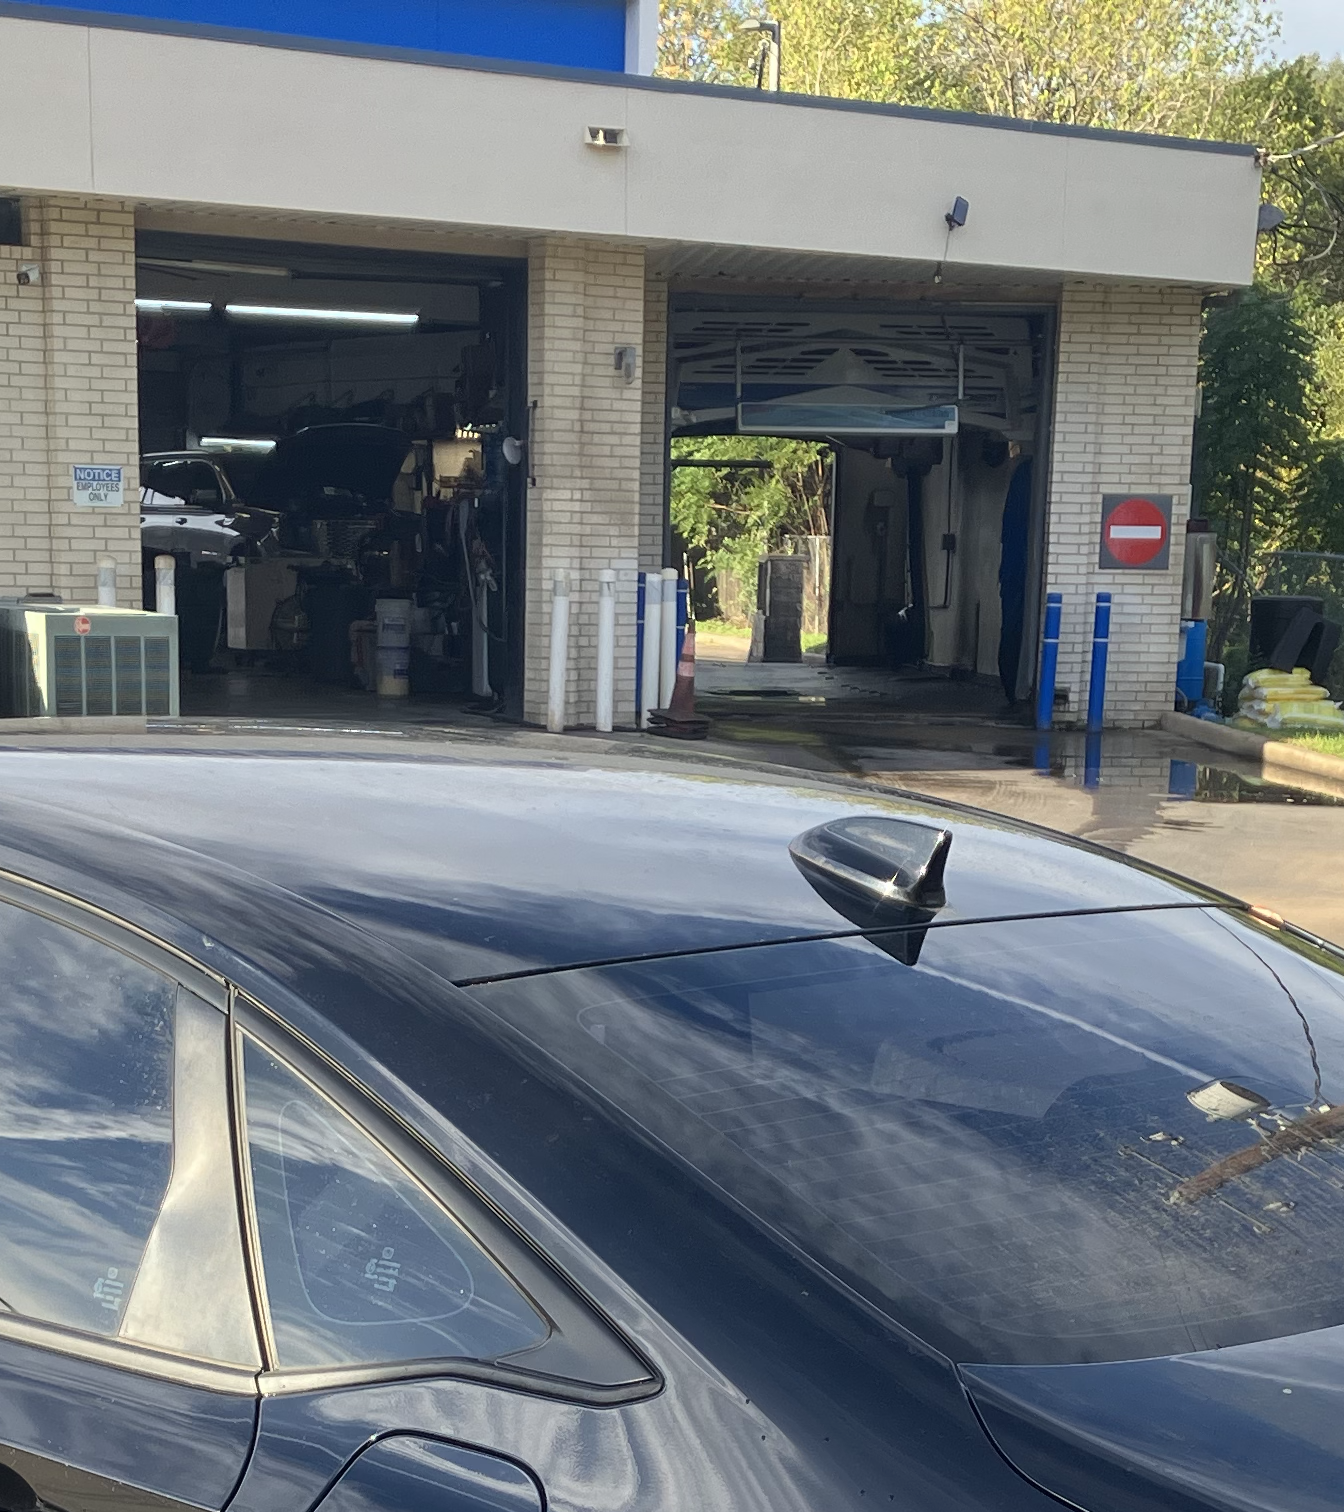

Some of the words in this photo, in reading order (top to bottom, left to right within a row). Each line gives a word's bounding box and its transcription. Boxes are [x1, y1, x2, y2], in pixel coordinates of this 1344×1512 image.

[76, 468, 119, 481] NOTICE
[76, 482, 120, 492] EMPLOYEES
[88, 492, 109, 502] ONLY
